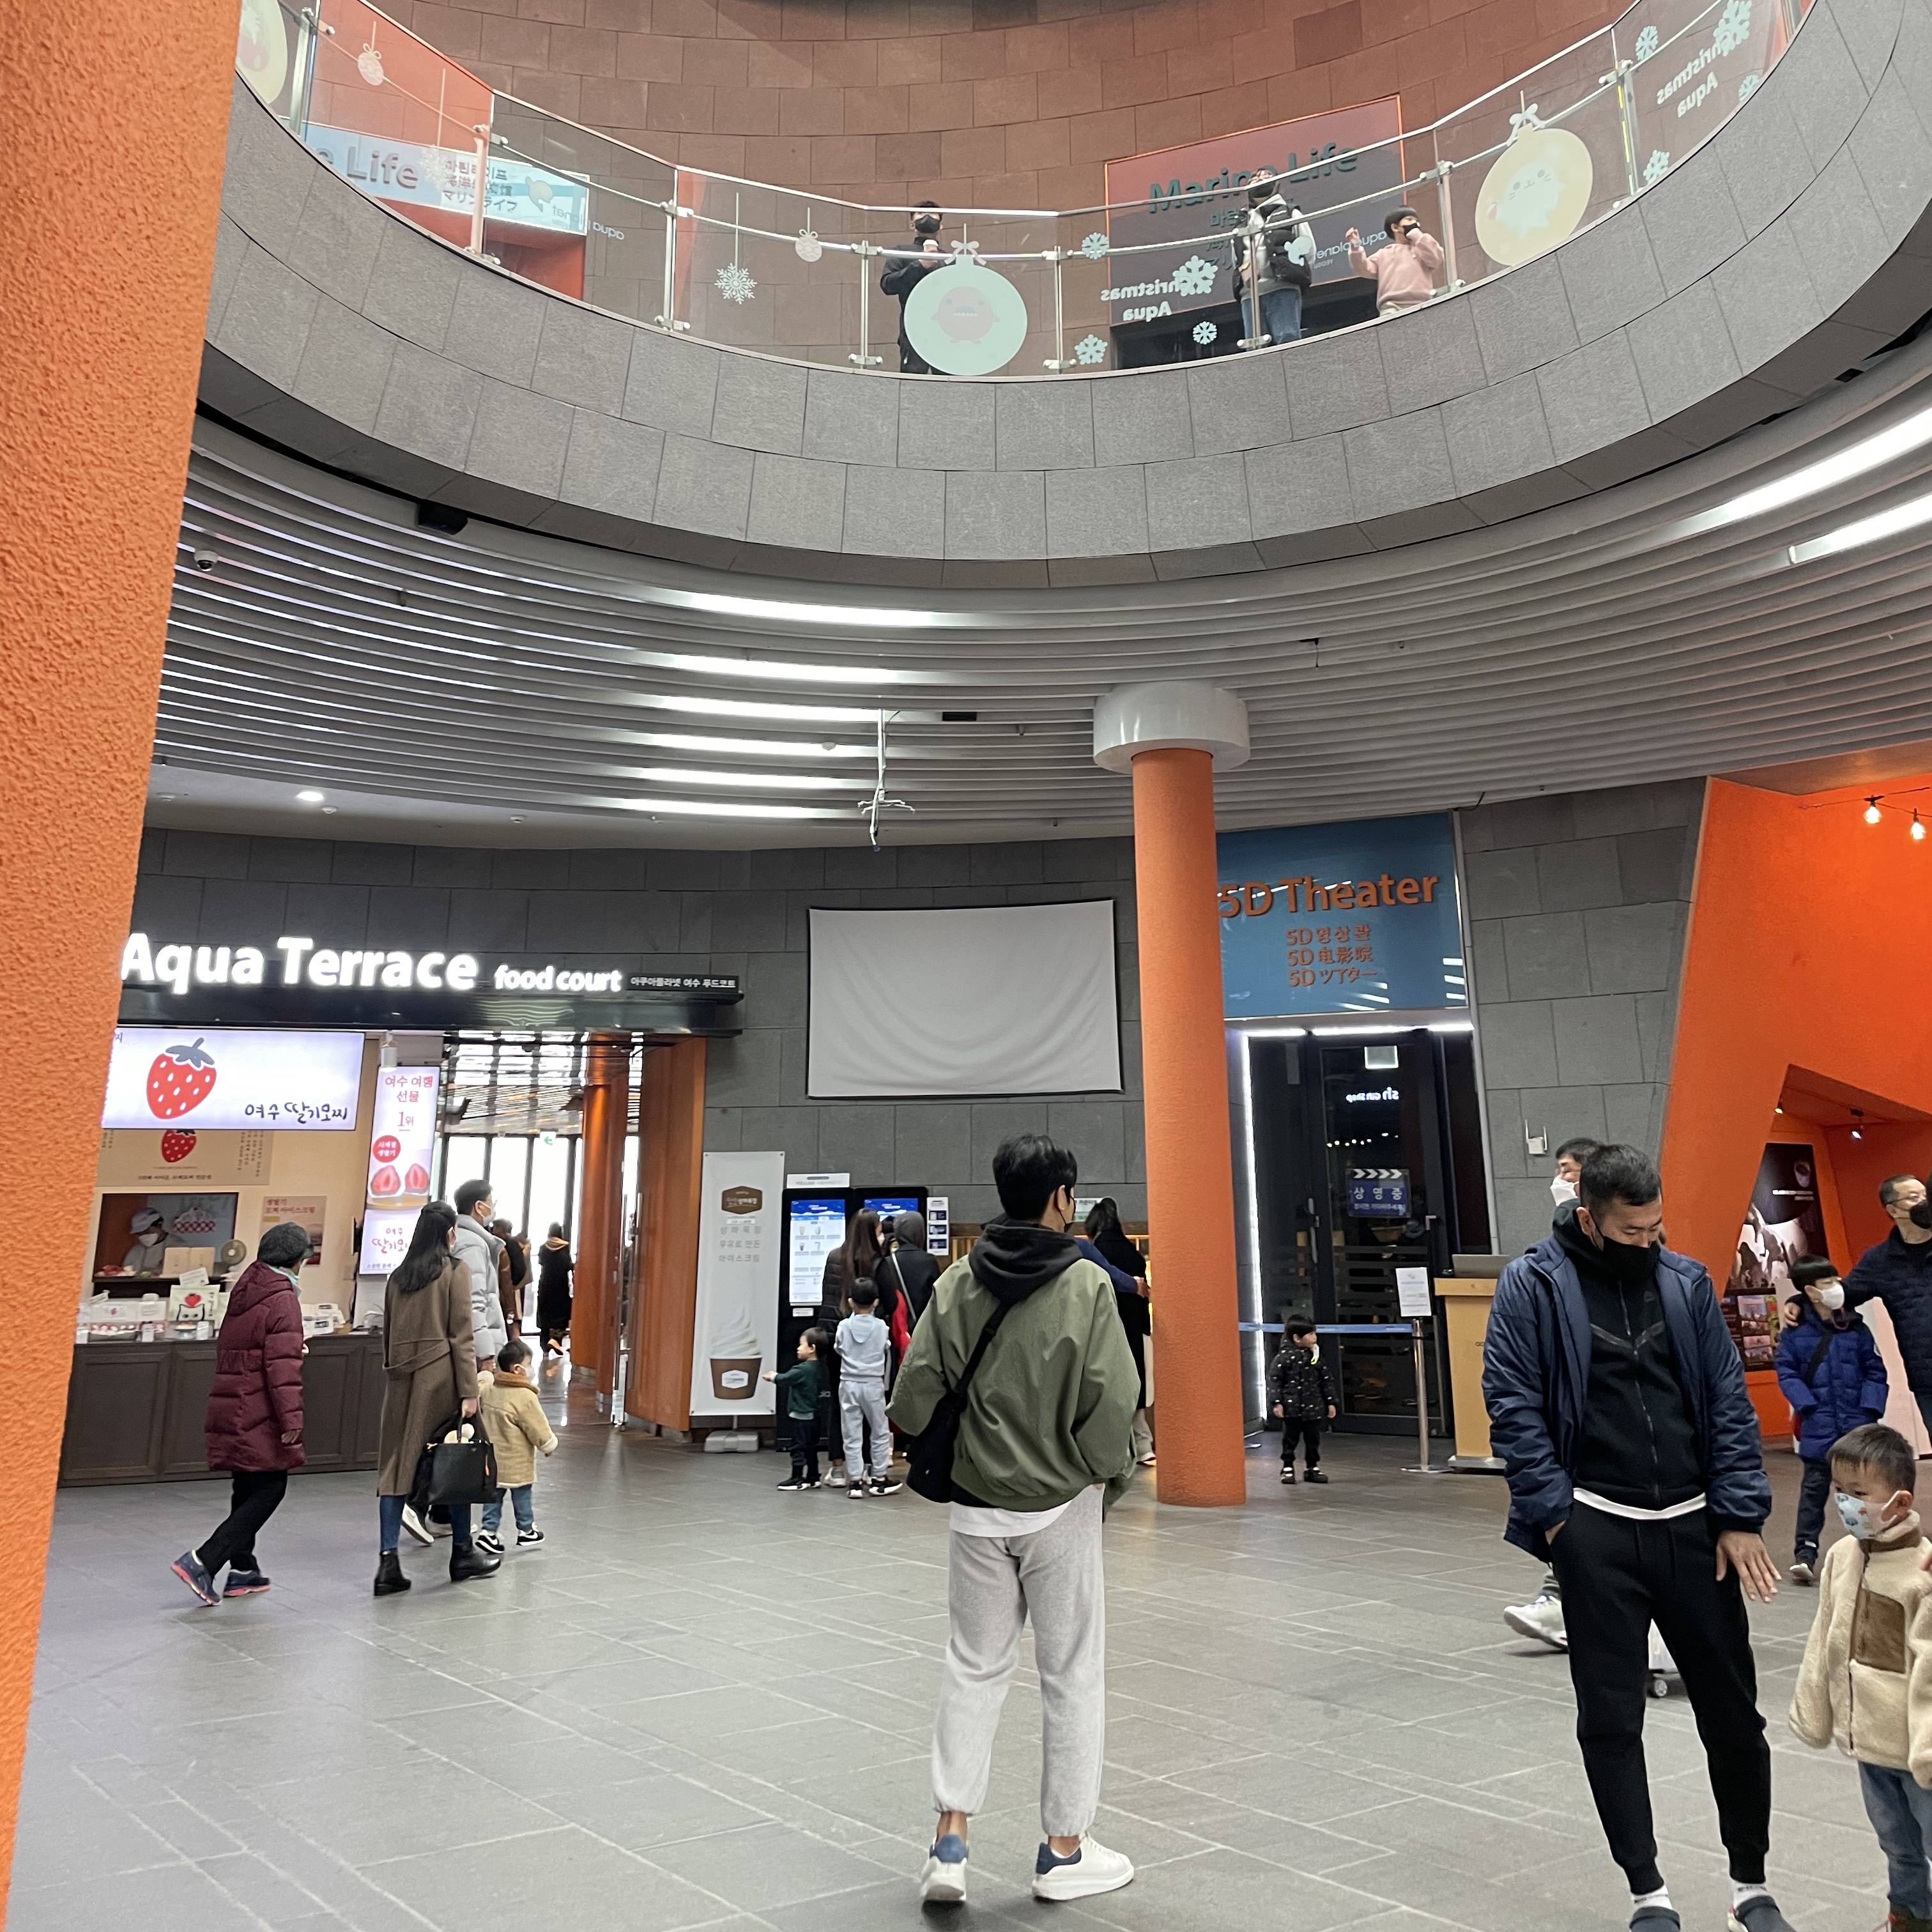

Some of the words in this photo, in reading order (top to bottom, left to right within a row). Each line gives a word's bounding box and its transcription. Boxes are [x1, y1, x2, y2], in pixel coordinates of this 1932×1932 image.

[347, 146, 419, 189] Life
[1288, 142, 1358, 183] Life
[1219, 882, 1273, 917] 5D
[1279, 873, 1438, 912] Theater
[1286, 927, 1313, 946] 5D
[121, 933, 264, 995] Aqua
[277, 937, 477, 990] Terrace
[494, 964, 555, 990] food
[556, 969, 622, 992] court
[1287, 947, 1314, 967] 5D
[683, 978, 701, 988] 여수
[1289, 969, 1315, 987] 5D
[385, 1075, 408, 1087] 여수
[411, 1075, 433, 1088] 여행
[396, 1090, 419, 1103] 선물
[244, 1103, 280, 1121] 여수
[284, 1101, 348, 1124] 딸기모찌
[397, 1111, 414, 1127] 1위
[385, 1227, 403, 1236] 여수
